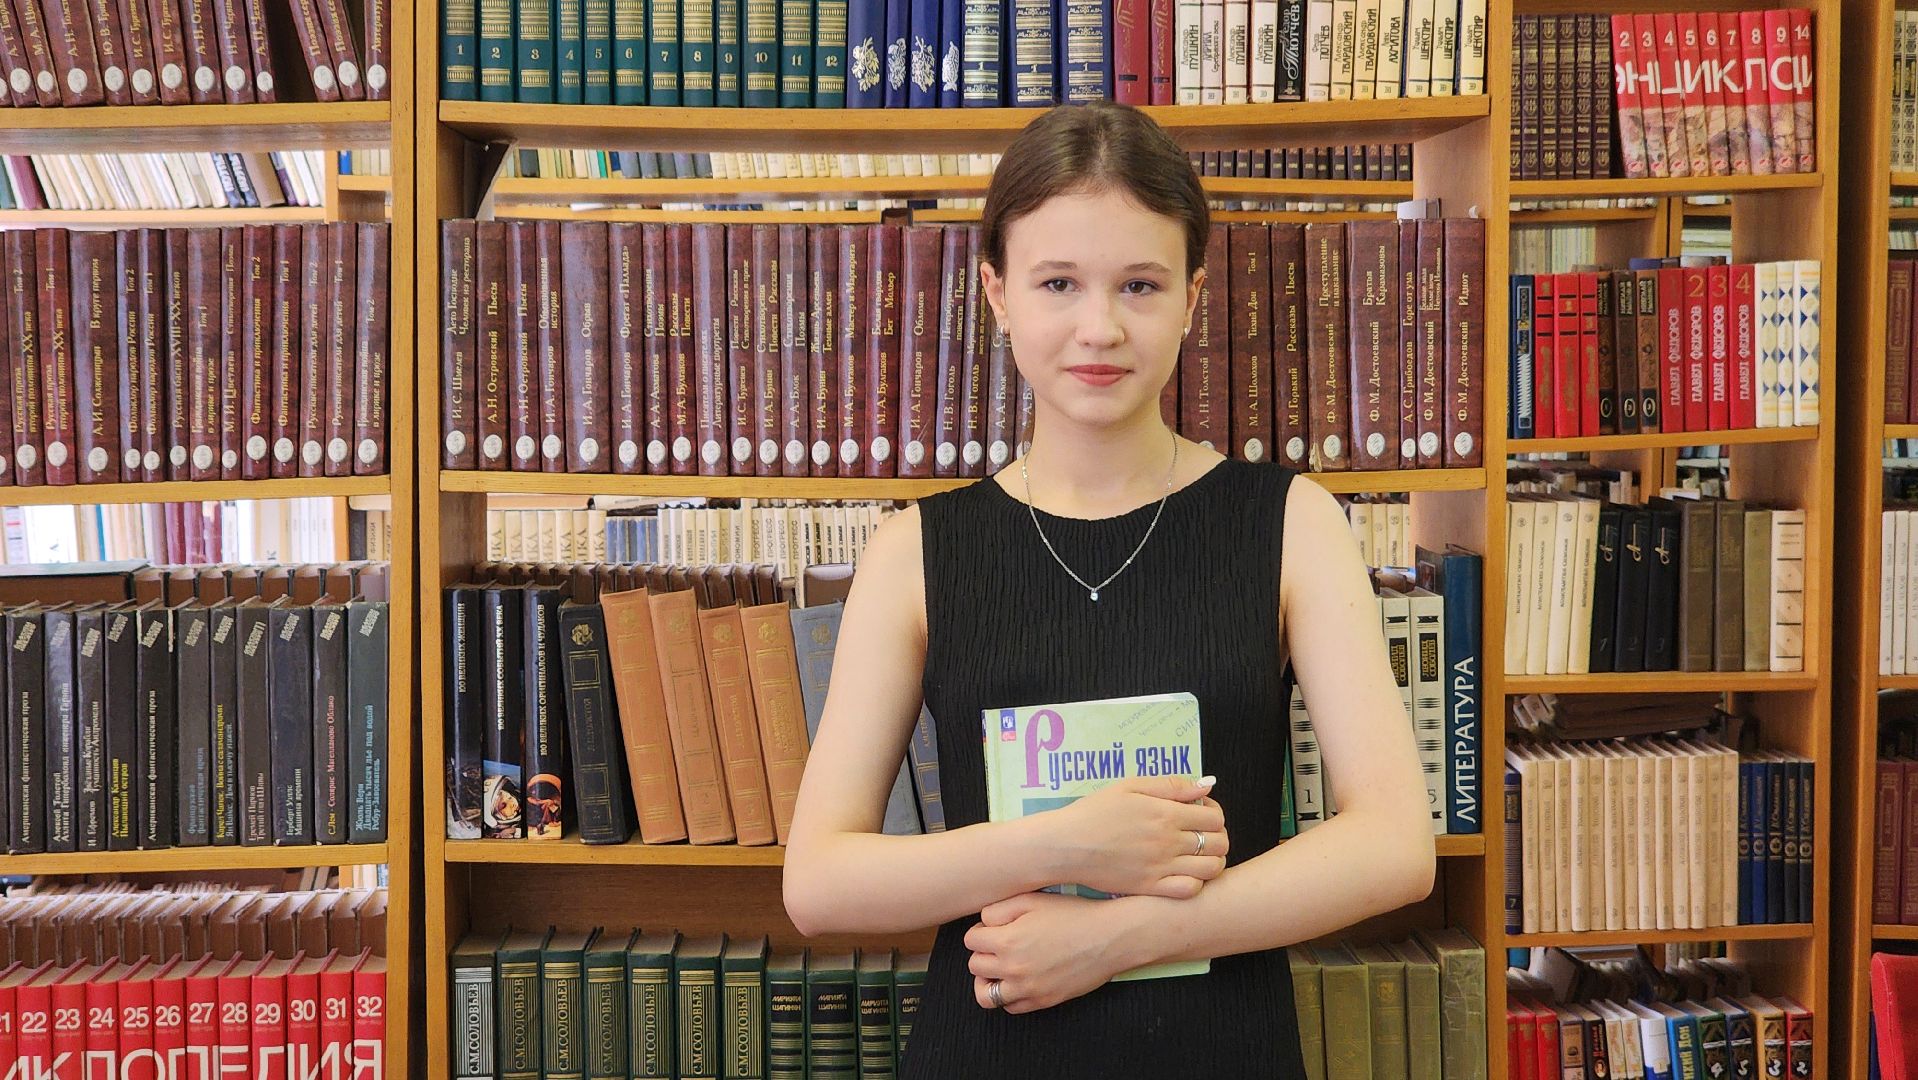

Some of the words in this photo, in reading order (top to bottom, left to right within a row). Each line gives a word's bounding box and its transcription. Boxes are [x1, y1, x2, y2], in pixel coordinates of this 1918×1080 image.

[1342, 11, 1353, 73] ТВАРДОВСКИЙ
[1365, 9, 1376, 71] ТВАРДОВСКИЙ
[1388, 17, 1400, 63] АХМАТОВА
[1420, 18, 1431, 60] ШЕКСПИР
[1444, 17, 1454, 59] ШЕКСПИР
[1473, 16, 1483, 57] ШЕКСПИР
[1620, 31, 1630, 47] 2
[1642, 31, 1652, 47] 3
[1664, 30, 1674, 45] 4
[1685, 30, 1695, 45] 5
[1706, 29, 1717, 45] 6
[1727, 30, 1736, 45] 7
[1752, 28, 1761, 44] 8
[1777, 27, 1787, 43] 9
[1794, 25, 1810, 40] 14
[456, 44, 464, 55] 1
[492, 47, 501, 59] 2
[531, 49, 539, 60] 3
[566, 49, 574, 60] 4
[595, 49, 602, 59] 5
[625, 48, 633, 59] 6
[1189, 25, 1199, 69] ПУШКИН
[1235, 25, 1245, 65] ПУШКИН
[1263, 24, 1273, 64] ПУШКИН
[661, 51, 669, 62] 7
[694, 51, 701, 62] 8
[724, 53, 732, 64] 9
[754, 52, 768, 63] 10
[791, 55, 802, 66] 11
[825, 56, 838, 67] 12
[91, 259, 101, 292] первом
[252, 265, 261, 281] Том
[846, 244, 857, 293] Маргарита
[1285, 262, 1296, 294] Пьесы
[1375, 245, 1386, 306] Карамазовы
[1363, 271, 1374, 306] Братья
[1458, 273, 1469, 306] Идиот
[1689, 274, 1704, 298] 2
[1711, 274, 1728, 296] 3
[1736, 272, 1750, 294] 4
[92, 294, 101, 318] круге
[488, 282, 498, 315] Пьесы
[91, 320, 101, 328] В
[846, 304, 857, 339] Мастер
[914, 291, 925, 335] Обломов
[253, 298, 262, 358] приключения
[1286, 305, 1297, 351] Рассказы
[1668, 308, 1681, 363] ФЕДОРОВ
[1690, 305, 1702, 360] ФЕДОРОВ
[1711, 305, 1724, 359] ФЕДОРОВ
[1736, 304, 1749, 358] ФЕДОРОВ
[488, 331, 499, 392] Островский
[1458, 321, 1470, 386] Достоевский
[92, 346, 103, 407] Солженицын
[845, 355, 856, 396] Булгаков
[912, 351, 923, 397] Гончаров
[1691, 363, 1703, 402] ПАВЕЛ
[1713, 362, 1724, 401] ПАВЕЛ
[1738, 361, 1750, 400] ПАВЕЛ
[251, 369, 261, 423] Фантастика
[1288, 368, 1299, 408] Горький
[1458, 389, 1468, 403] М.
[1670, 366, 1681, 405] ПАВЕЛ
[488, 395, 498, 408] Н.
[846, 400, 854, 410] А.
[912, 400, 921, 412] А.
[94, 409, 102, 421] И.
[488, 410, 498, 423] А.
[845, 414, 854, 427] М.
[911, 416, 921, 429] И.
[1289, 411, 1299, 425] М.
[1458, 406, 1468, 420] Ф.
[94, 424, 103, 435] А.
[766, 518, 774, 558] ПРОГРЕСС
[148, 690, 156, 713] проза
[148, 715, 156, 780] фантастическая
[1454, 656, 1476, 823] ЛИТЕРАТУРА
[1304, 789, 1313, 804] 1
[1427, 789, 1437, 804] 5
[148, 782, 157, 841] Американская
[89, 1007, 115, 1028] 24
[123, 1007, 149, 1028] 25
[155, 1005, 181, 1027] 26
[189, 1002, 214, 1024] 27
[222, 1002, 248, 1024] 28
[255, 1003, 281, 1025] 29
[290, 999, 316, 1021] 30
[326, 997, 347, 1019] 31
[357, 996, 382, 1018] 32
[22, 1012, 47, 1033] 22
[55, 1008, 81, 1030] 23
